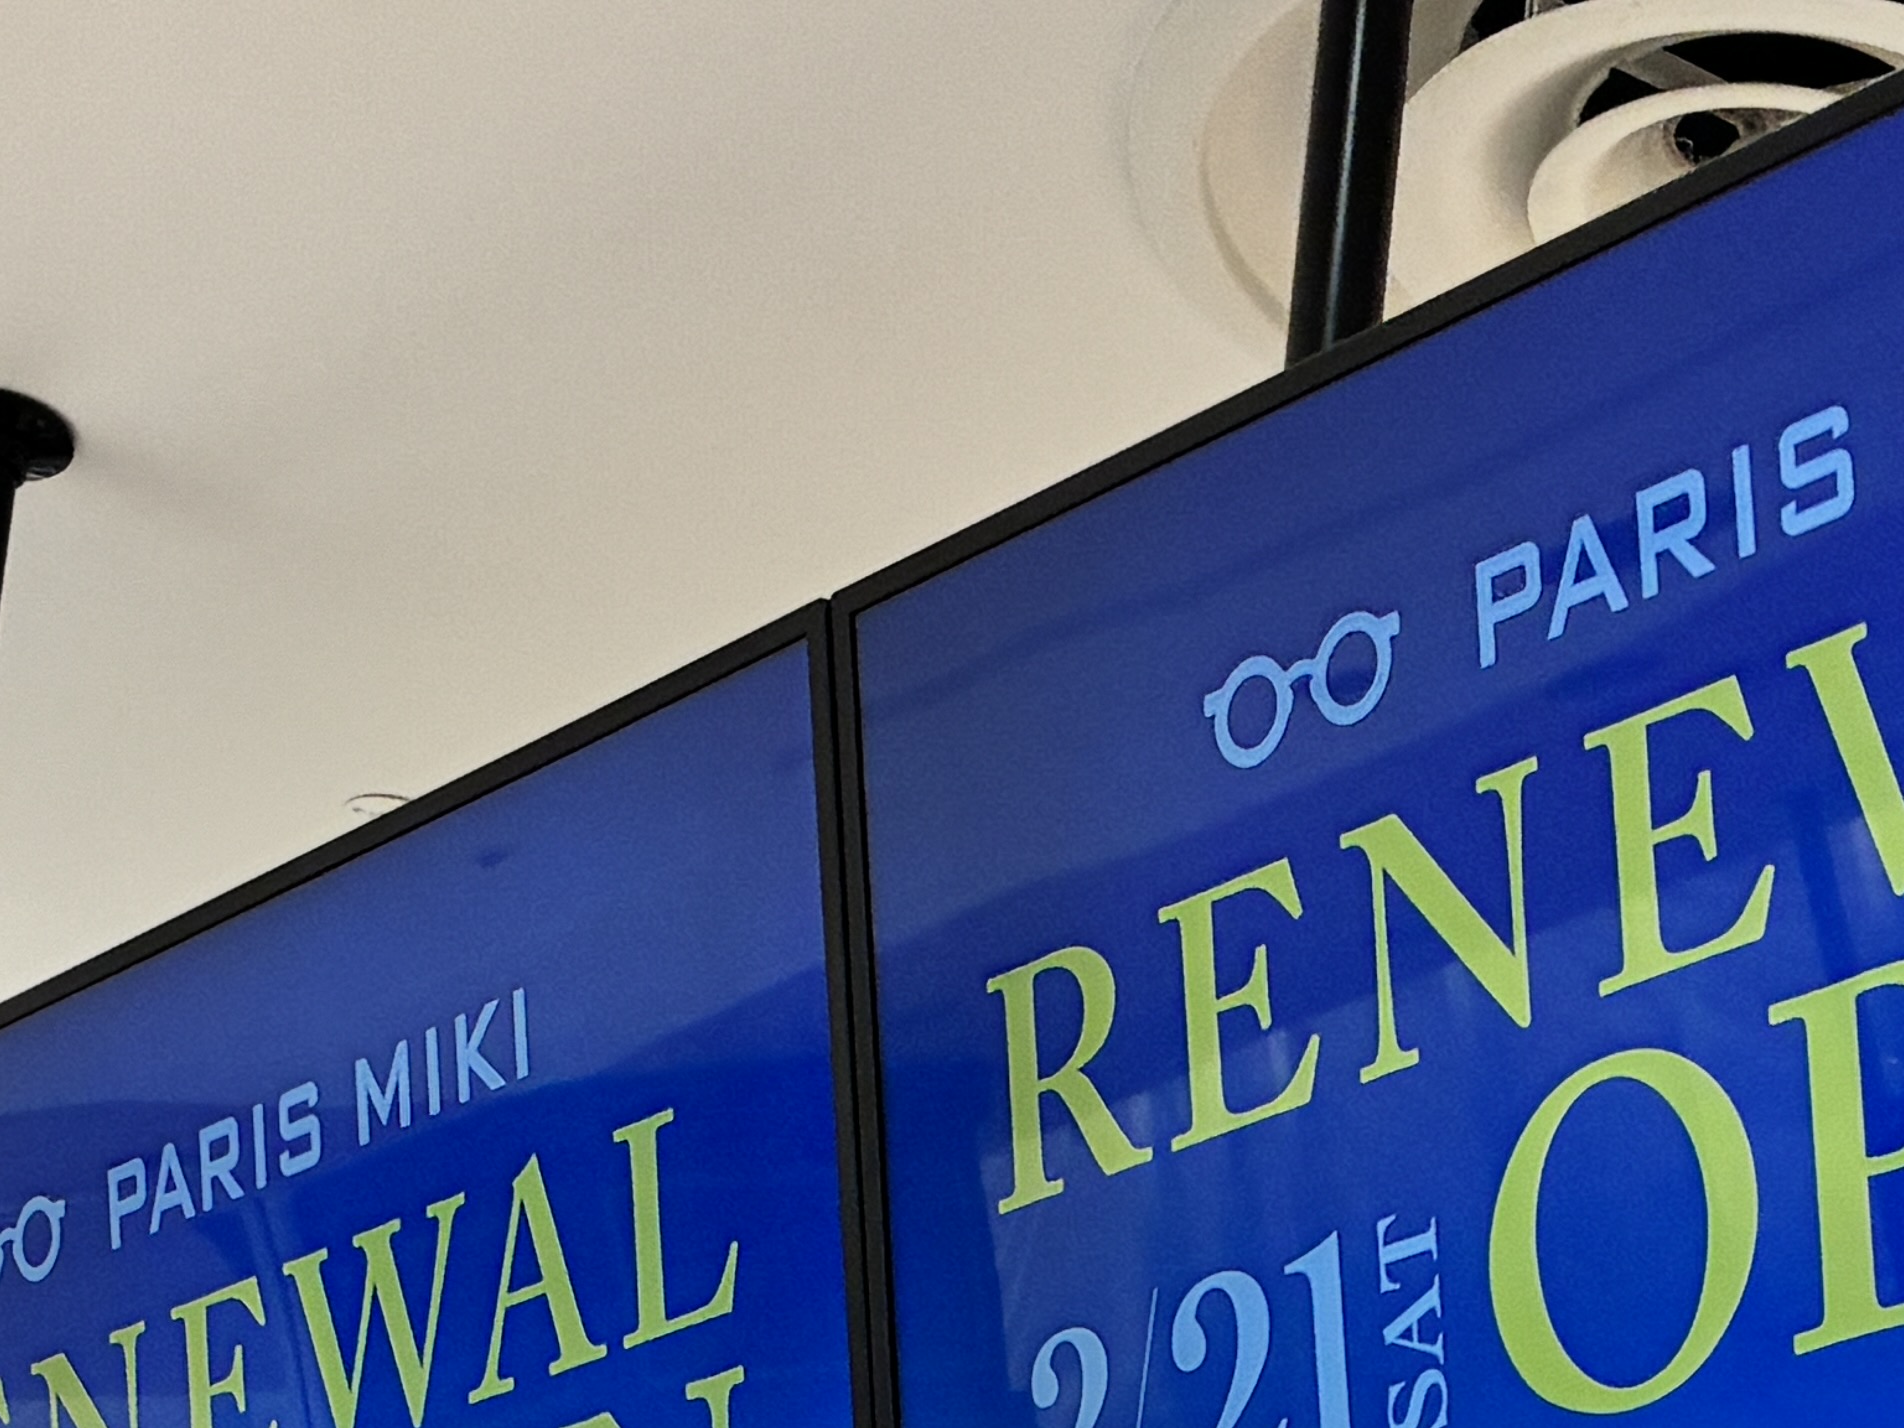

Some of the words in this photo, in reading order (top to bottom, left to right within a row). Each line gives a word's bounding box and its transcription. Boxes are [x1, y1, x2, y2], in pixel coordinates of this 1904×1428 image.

[1473, 405, 1857, 669] PARIS
[107, 1081, 321, 1250] PARIS
[355, 988, 531, 1146] MIKI
